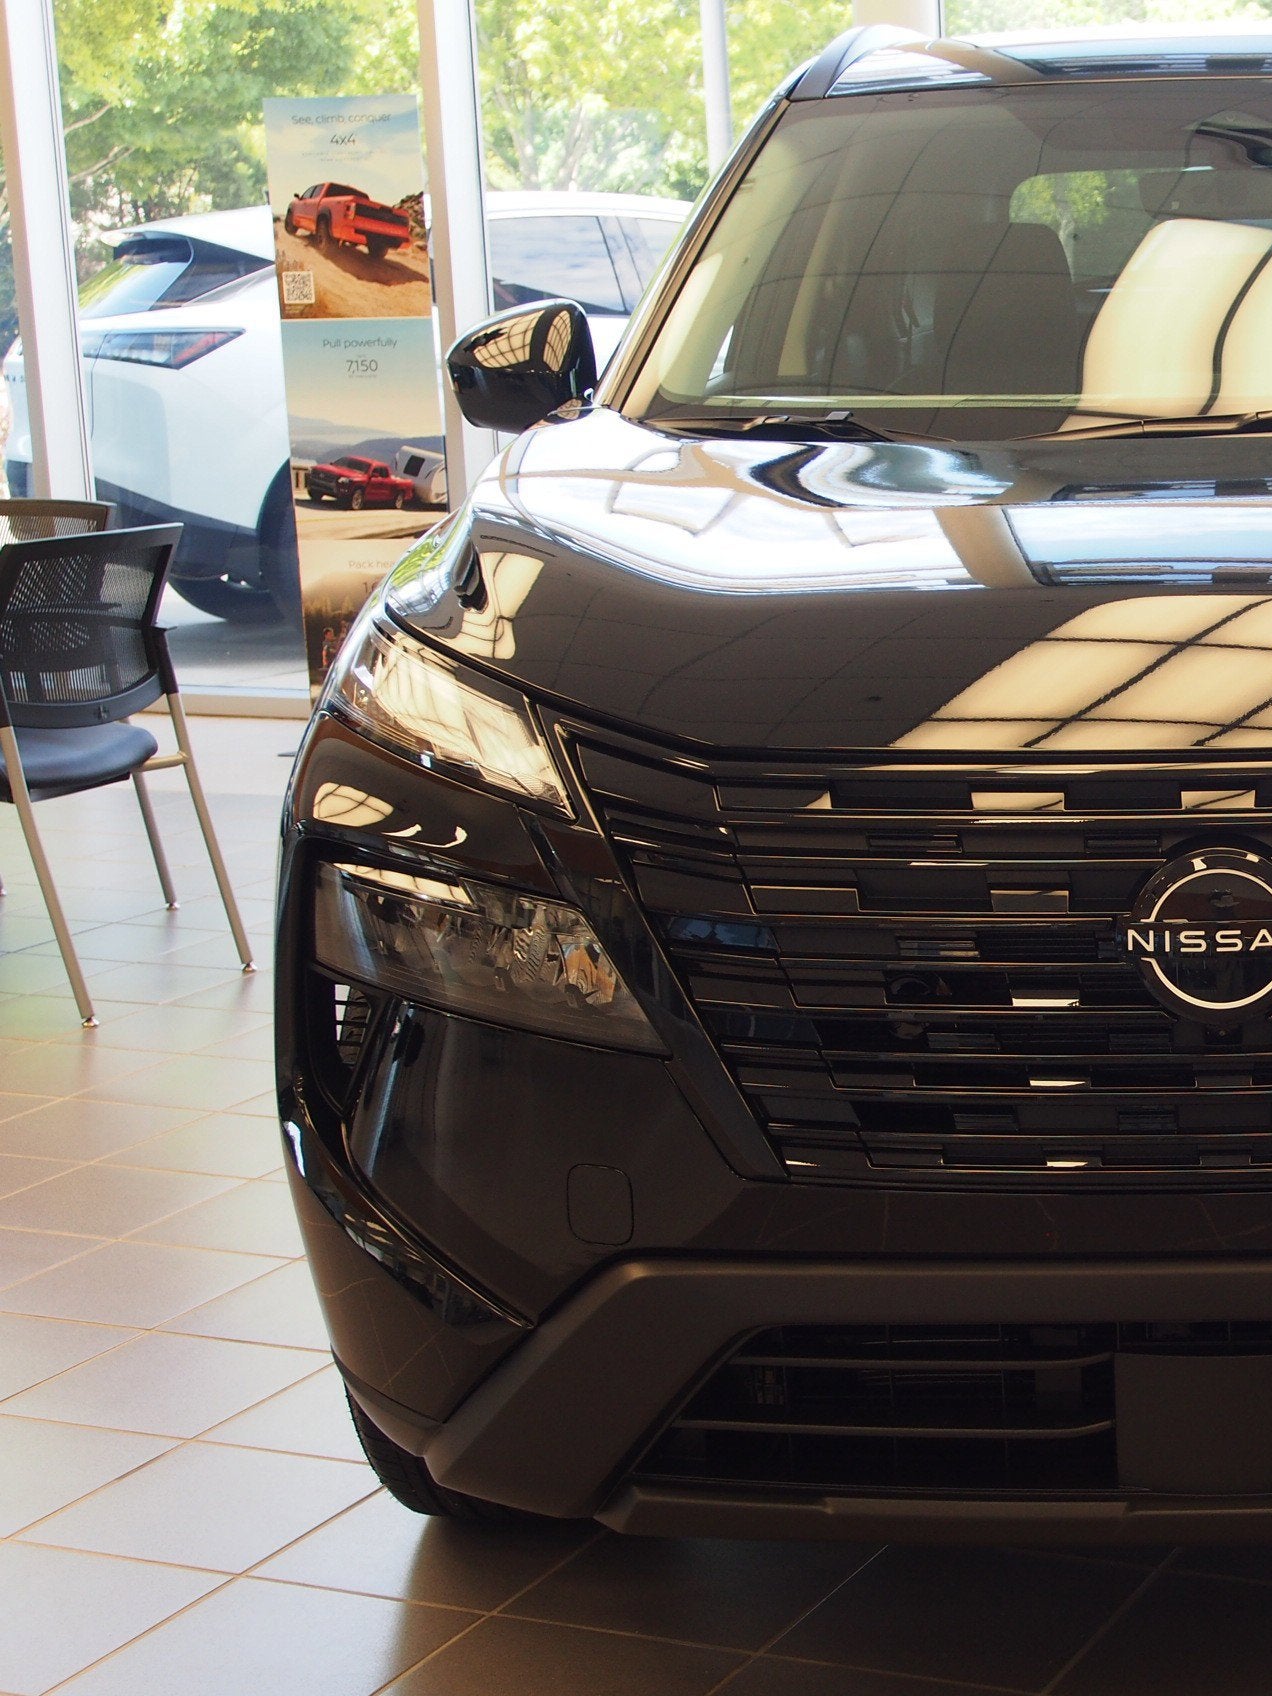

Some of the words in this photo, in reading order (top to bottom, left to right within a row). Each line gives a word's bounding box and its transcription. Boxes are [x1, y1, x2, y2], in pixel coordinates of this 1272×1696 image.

[348, 112, 392, 125] conquer
[322, 338, 341, 348] Pull
[343, 336, 398, 349] powerfully
[345, 358, 379, 374] 7,150
[348, 559, 374, 569] Pack
